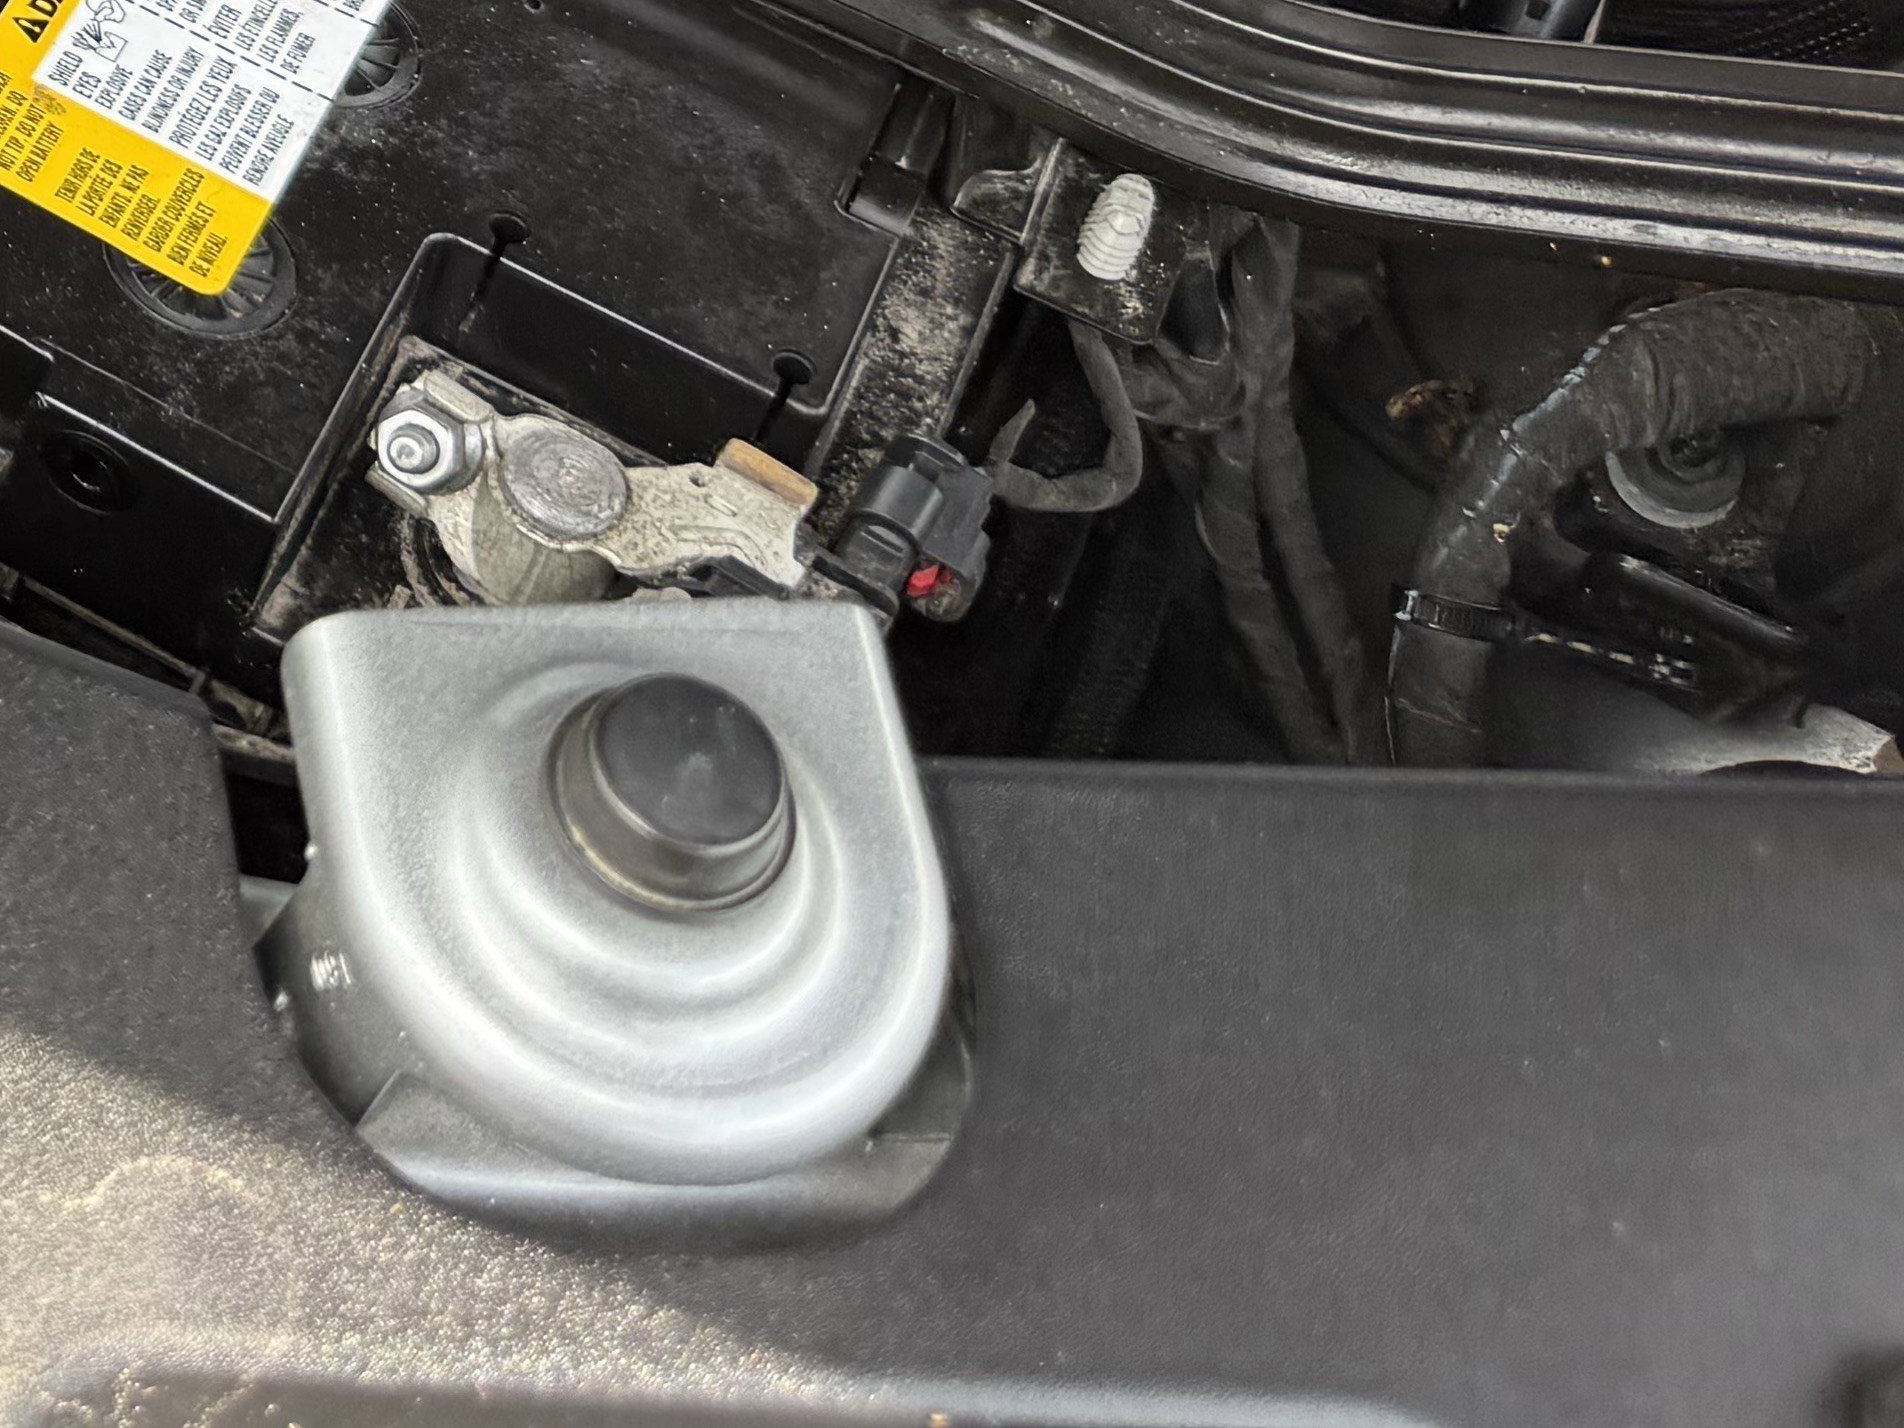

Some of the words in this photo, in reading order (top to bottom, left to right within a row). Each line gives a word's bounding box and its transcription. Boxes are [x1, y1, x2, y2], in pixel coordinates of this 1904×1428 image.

[178, 6, 200, 23] OR
[200, 0, 242, 39] ÉVITER
[232, 31, 256, 51] LES
[255, 43, 279, 63] LES
[285, 30, 316, 63] FUMER
[47, 49, 84, 87] SHIELD
[142, 48, 172, 79] CAUSE
[174, 45, 206, 79] INJURY
[205, 54, 237, 86] YEUX
[279, 58, 300, 74] DE
[71, 70, 102, 99] EYES
[94, 63, 134, 109] EXPLOSIVE
[132, 74, 157, 96] CAN
[166, 73, 189, 91] OR
[195, 79, 223, 103] LES
[22, 102, 47, 125] NOT
[117, 90, 147, 121] GASES
[141, 85, 181, 134] BLINDNESS
[213, 82, 252, 129] EXPLOSIFS
[14, 120, 37, 138] DO
[163, 94, 212, 149] PROTÉGEZ
[203, 124, 228, 145] GAZ
[217, 132, 253, 174] PEUVENT
[238, 98, 273, 138] BLESSER
[258, 86, 280, 104] OU
[28, 120, 64, 161] BATTERY
[194, 140, 218, 161] LES
[241, 149, 275, 186] RENDRE
[259, 113, 295, 155] AVEUGLE
[15, 155, 43, 183] OPEN
[124, 163, 149, 184] PAS
[75, 199, 98, 217] LA
[98, 157, 123, 179] DES
[188, 259, 210, 278] DE
